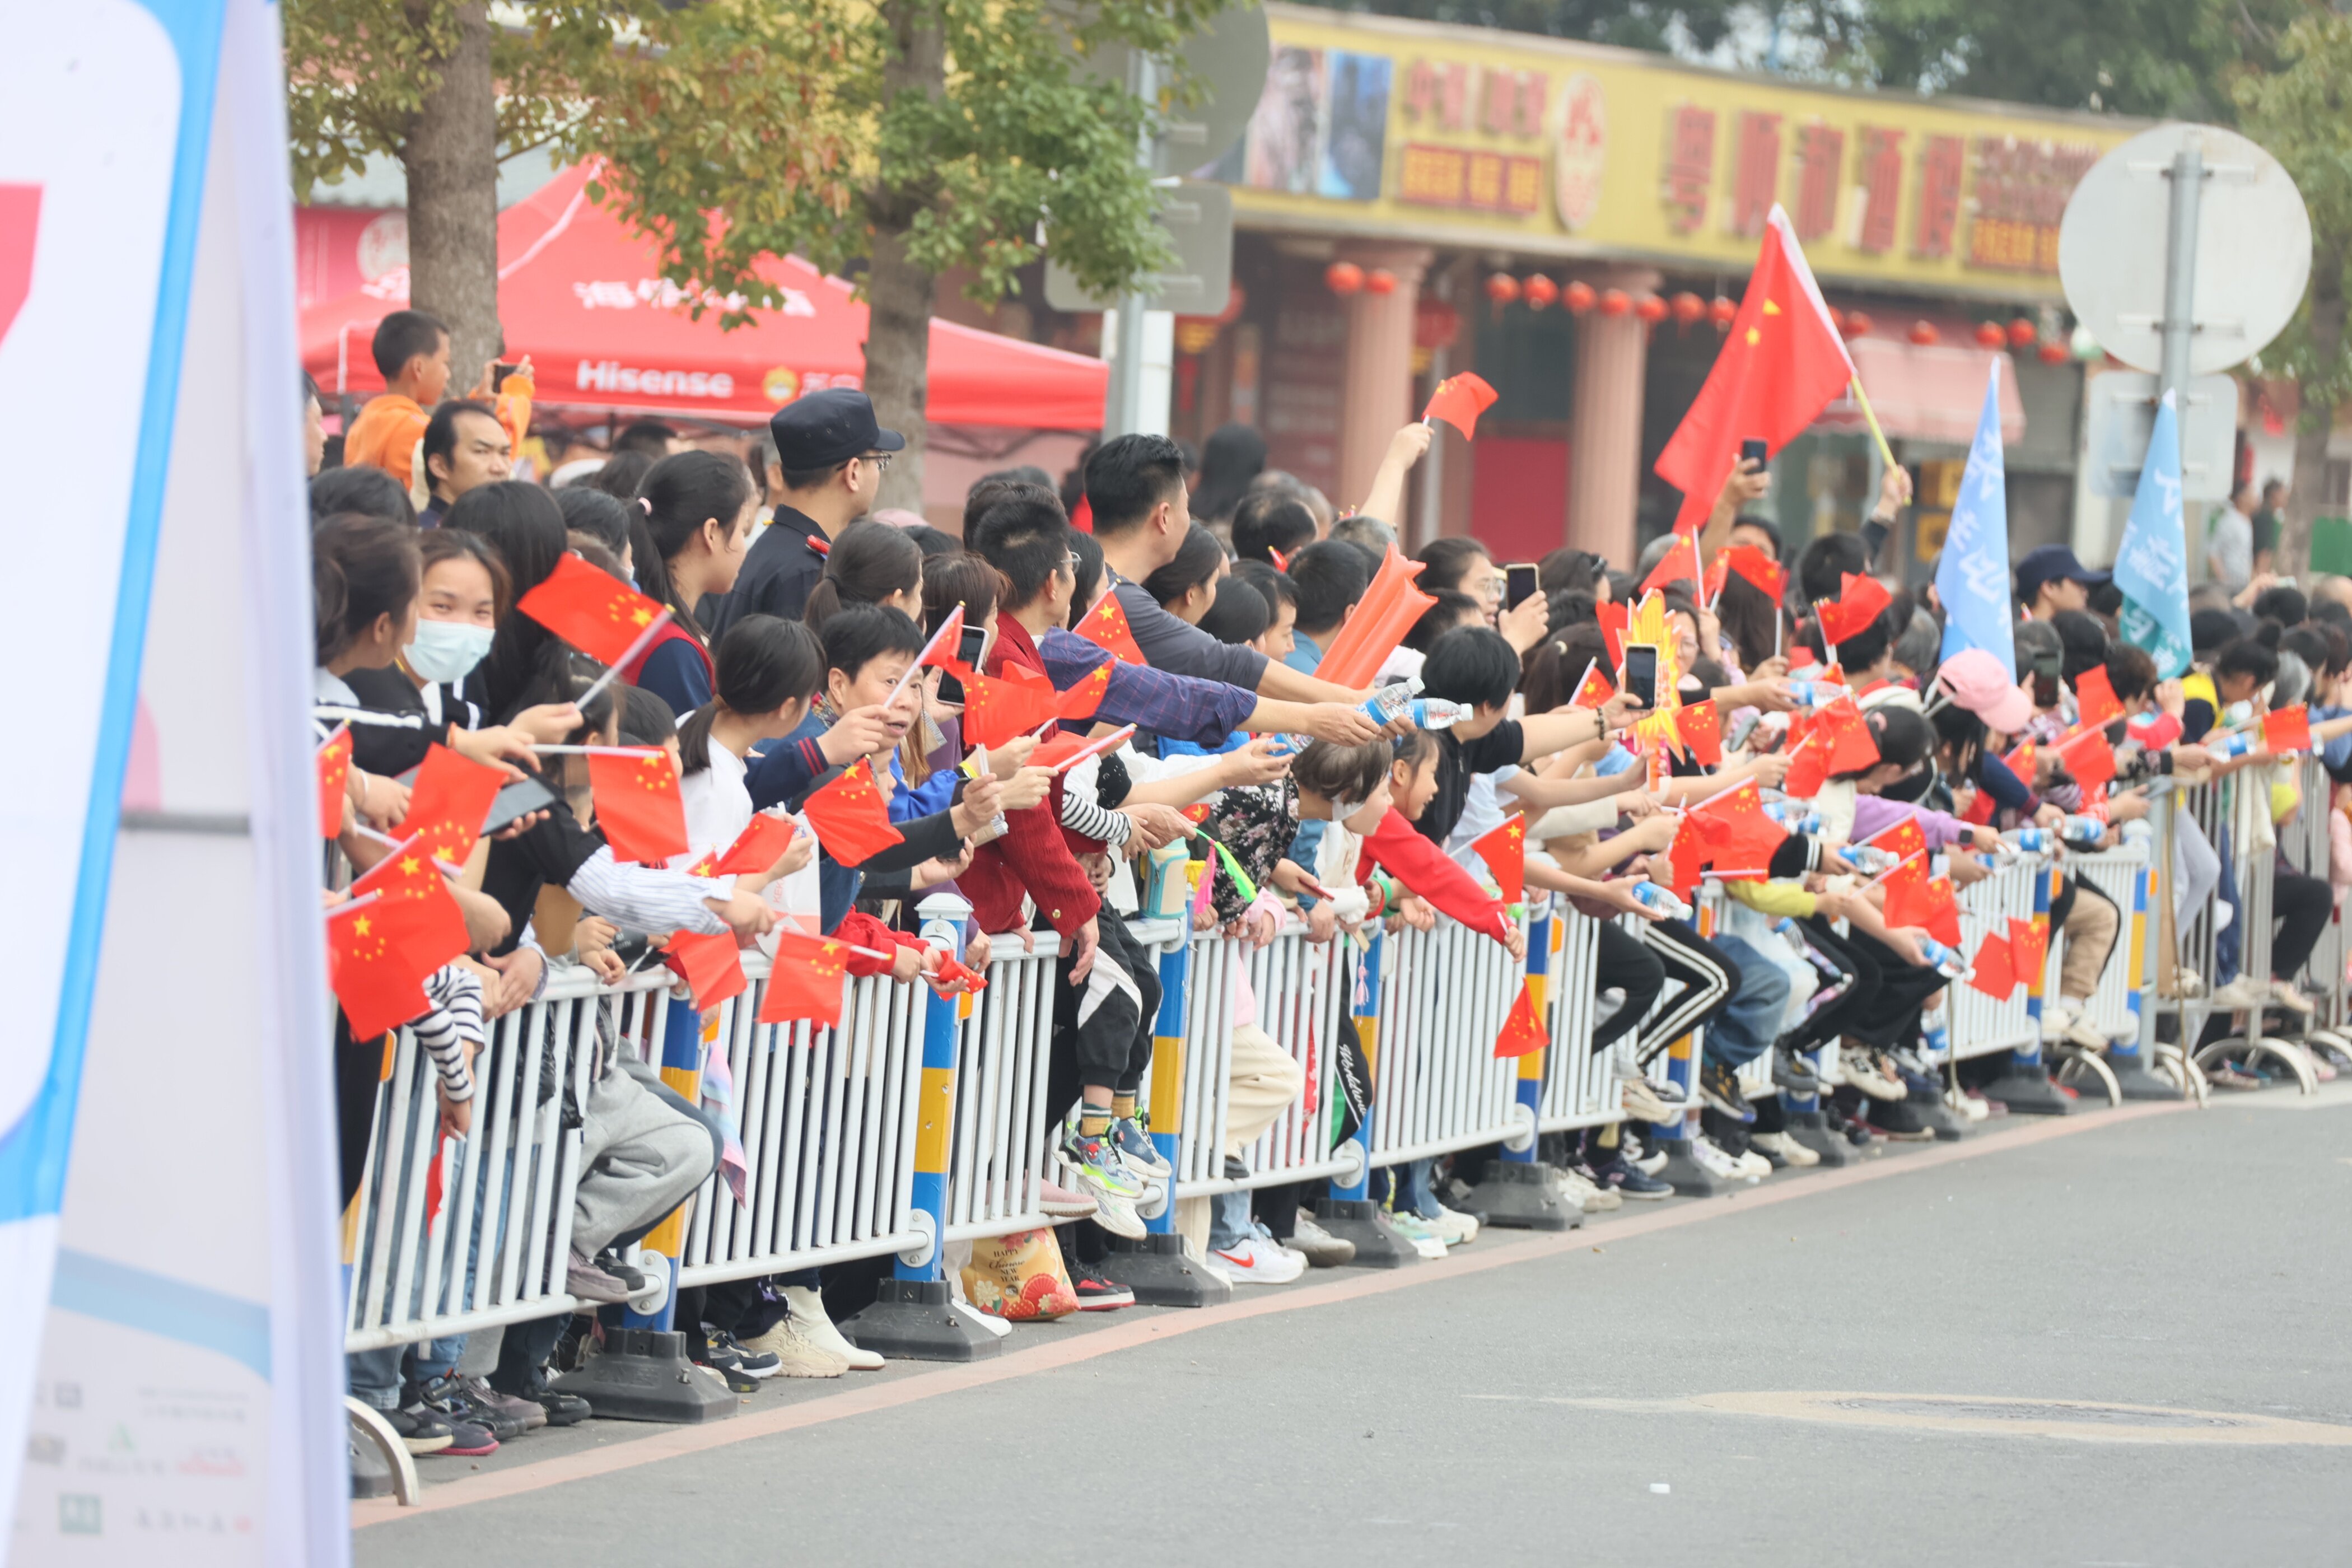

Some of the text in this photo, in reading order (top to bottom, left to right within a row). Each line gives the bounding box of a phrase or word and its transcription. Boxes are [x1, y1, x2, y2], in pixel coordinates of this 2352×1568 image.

[576, 359, 734, 398] Hisense
[993, 1248, 1019, 1257] HAPPY
[988, 1257, 1025, 1270] Chinese
